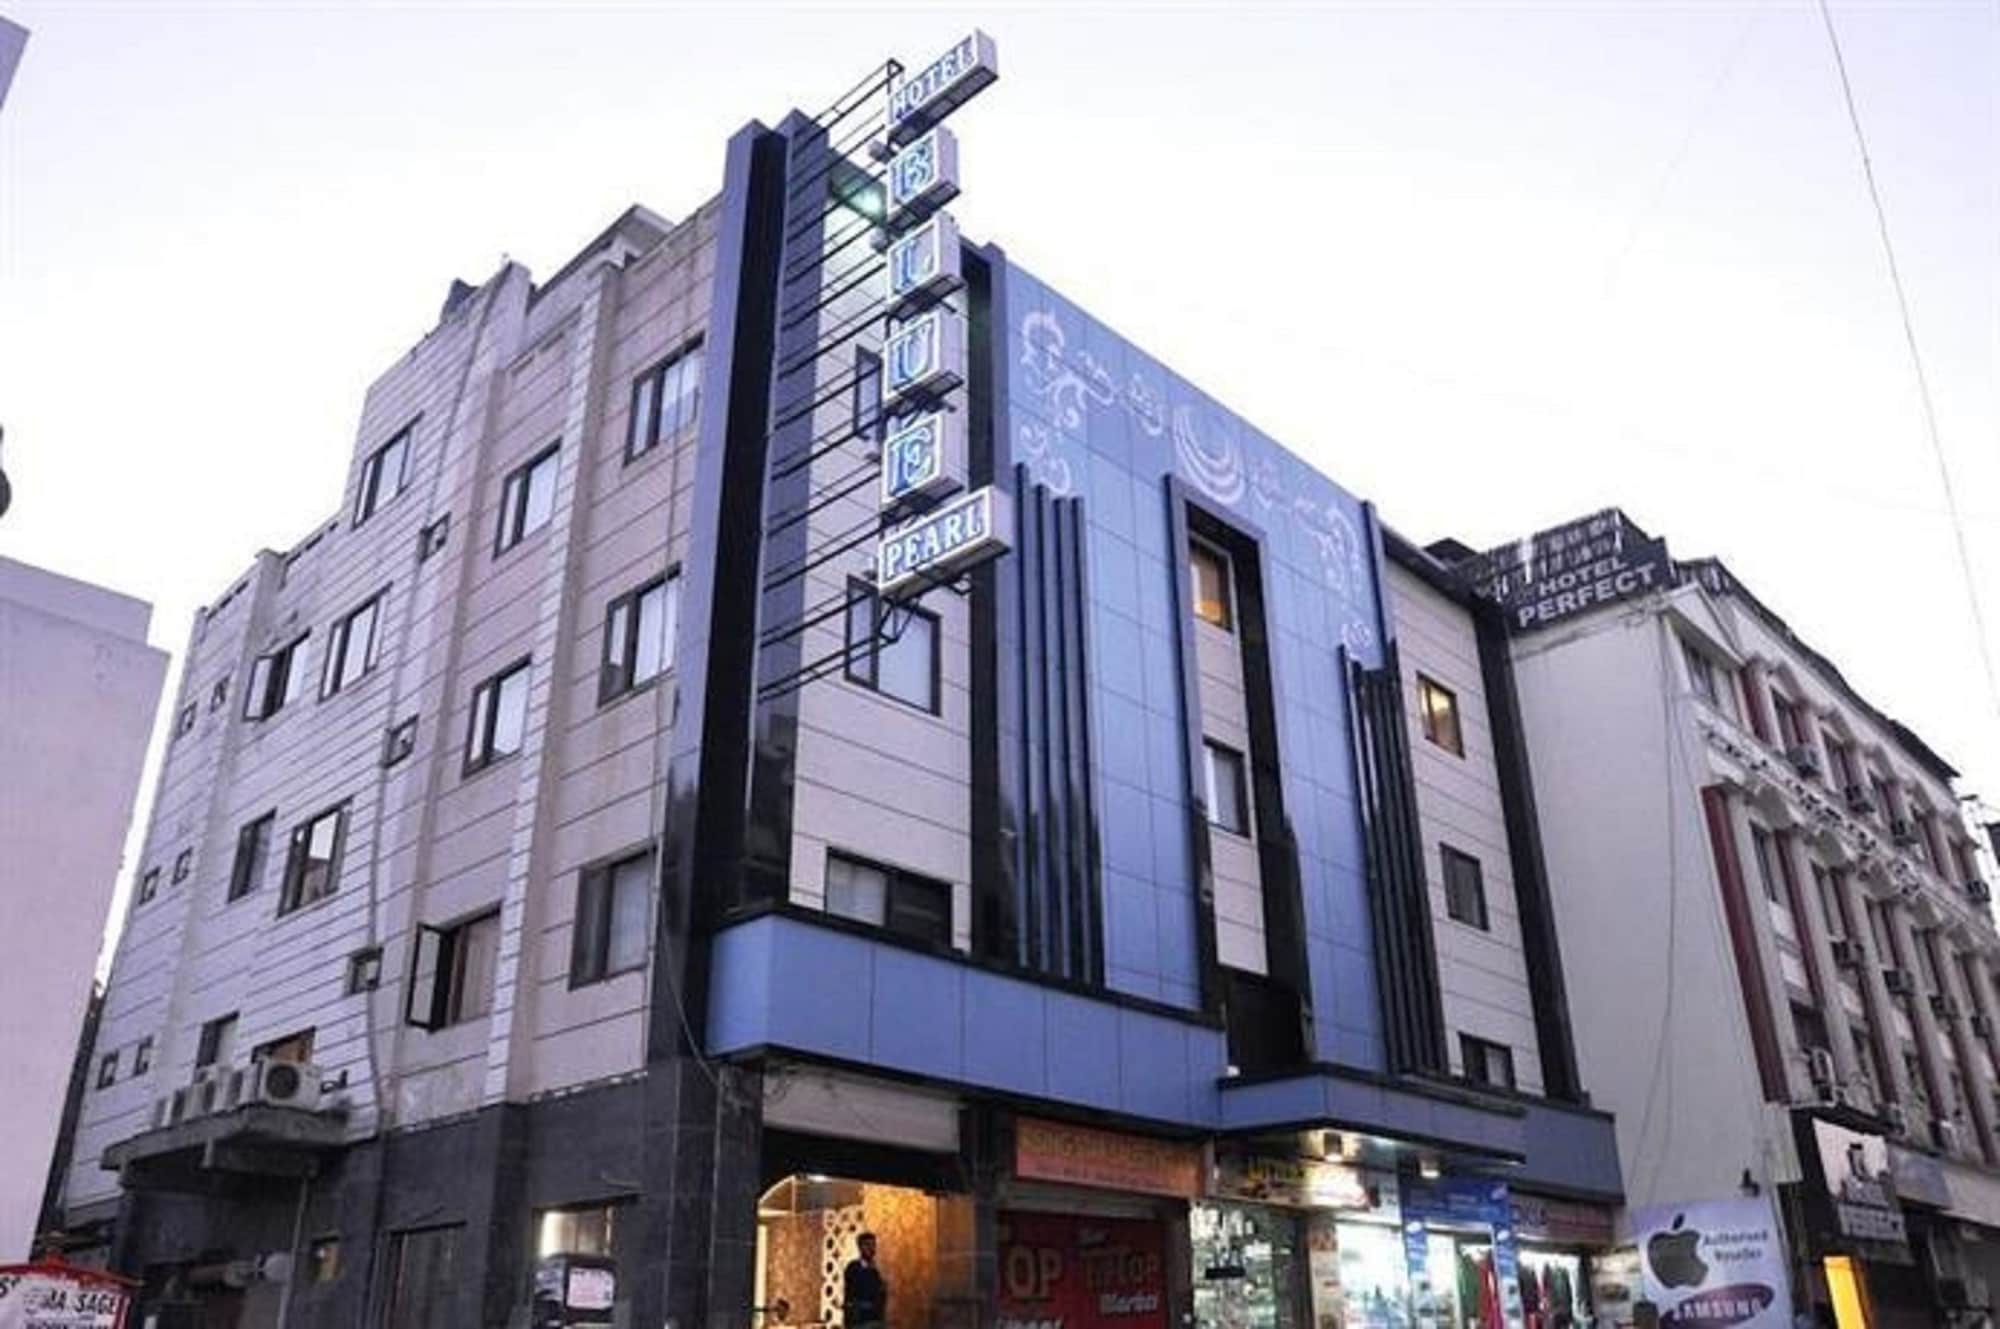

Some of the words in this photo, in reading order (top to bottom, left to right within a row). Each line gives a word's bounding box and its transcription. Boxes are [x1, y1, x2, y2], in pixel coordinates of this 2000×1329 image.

[893, 42, 976, 119] HOTEL
[885, 505, 982, 579] PEARL
[1539, 556, 1627, 596] HOTEL
[1518, 563, 1656, 628] PERFECT
